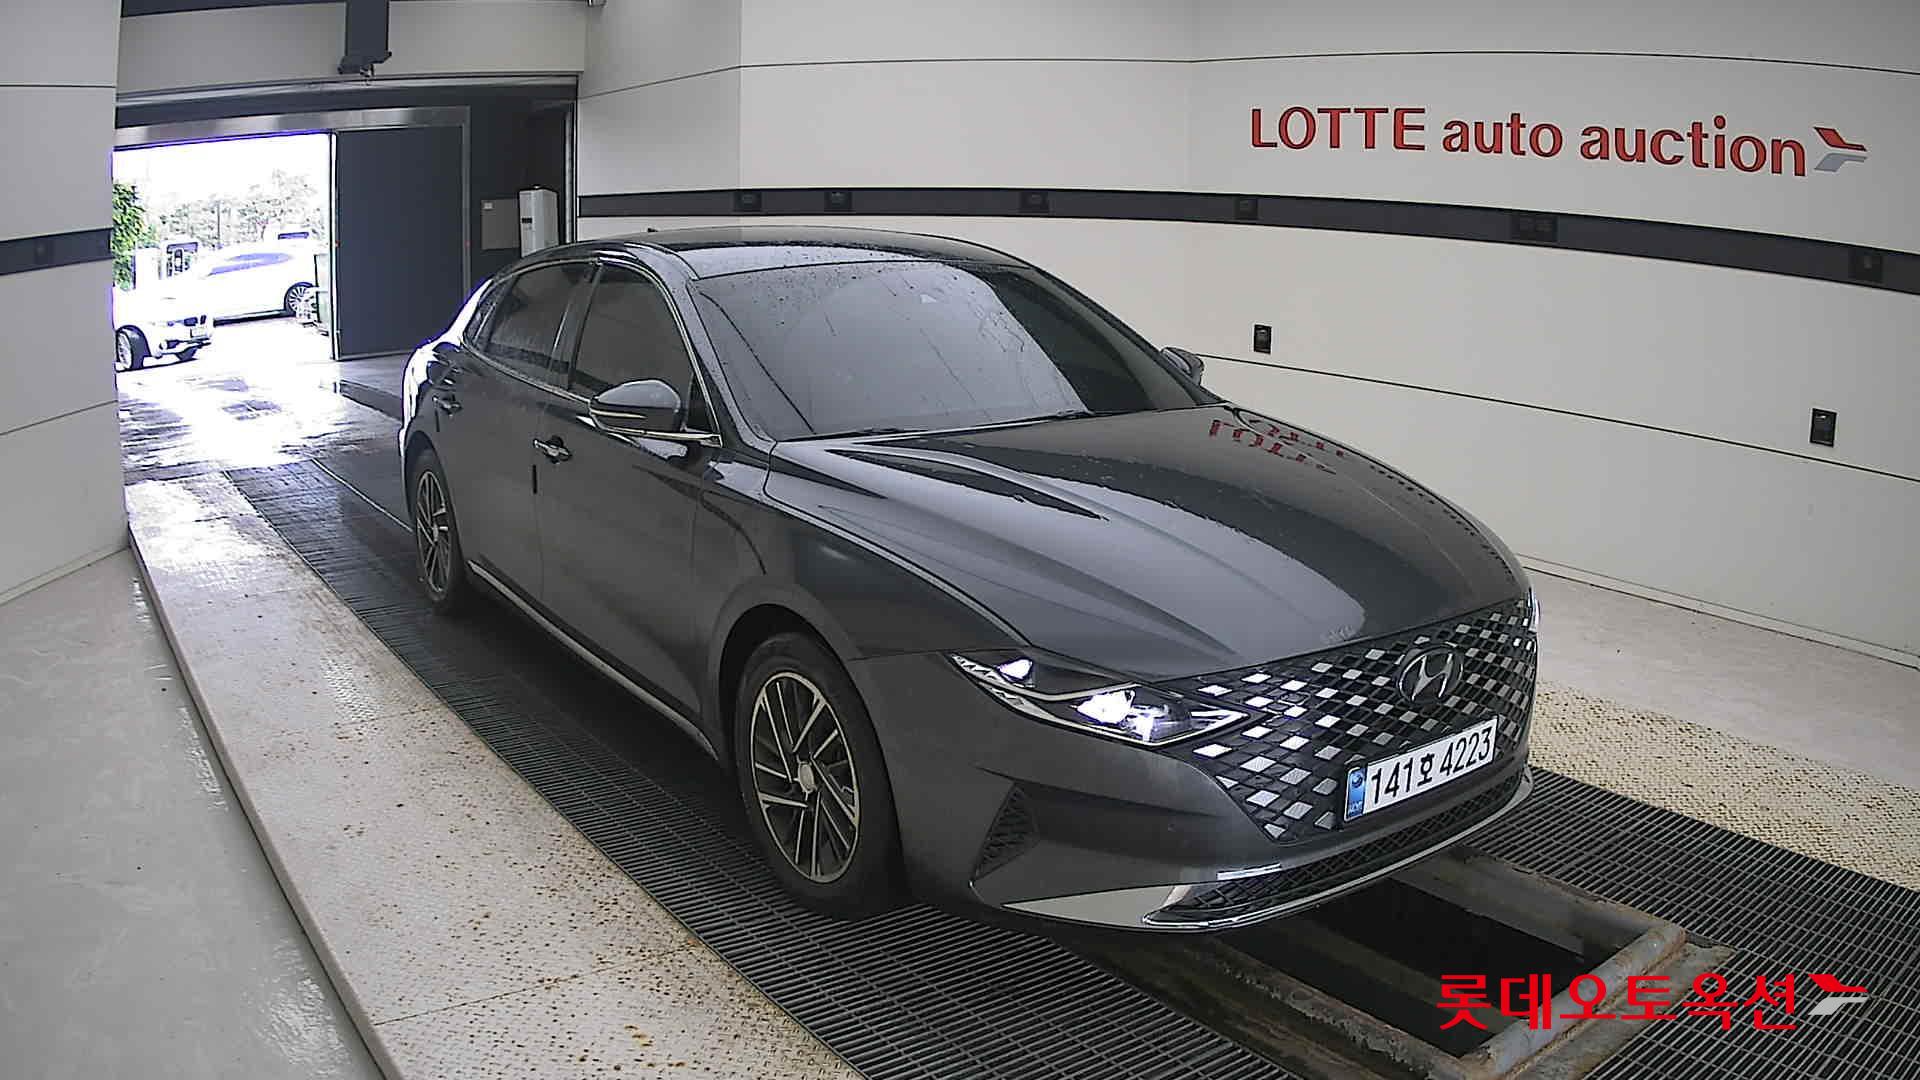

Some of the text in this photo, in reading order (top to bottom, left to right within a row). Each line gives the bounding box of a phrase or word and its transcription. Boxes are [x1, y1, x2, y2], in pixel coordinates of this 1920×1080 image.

[1251, 106, 1807, 177] LOTTE auto auction
[1371, 726, 1493, 804] 141호 4223
